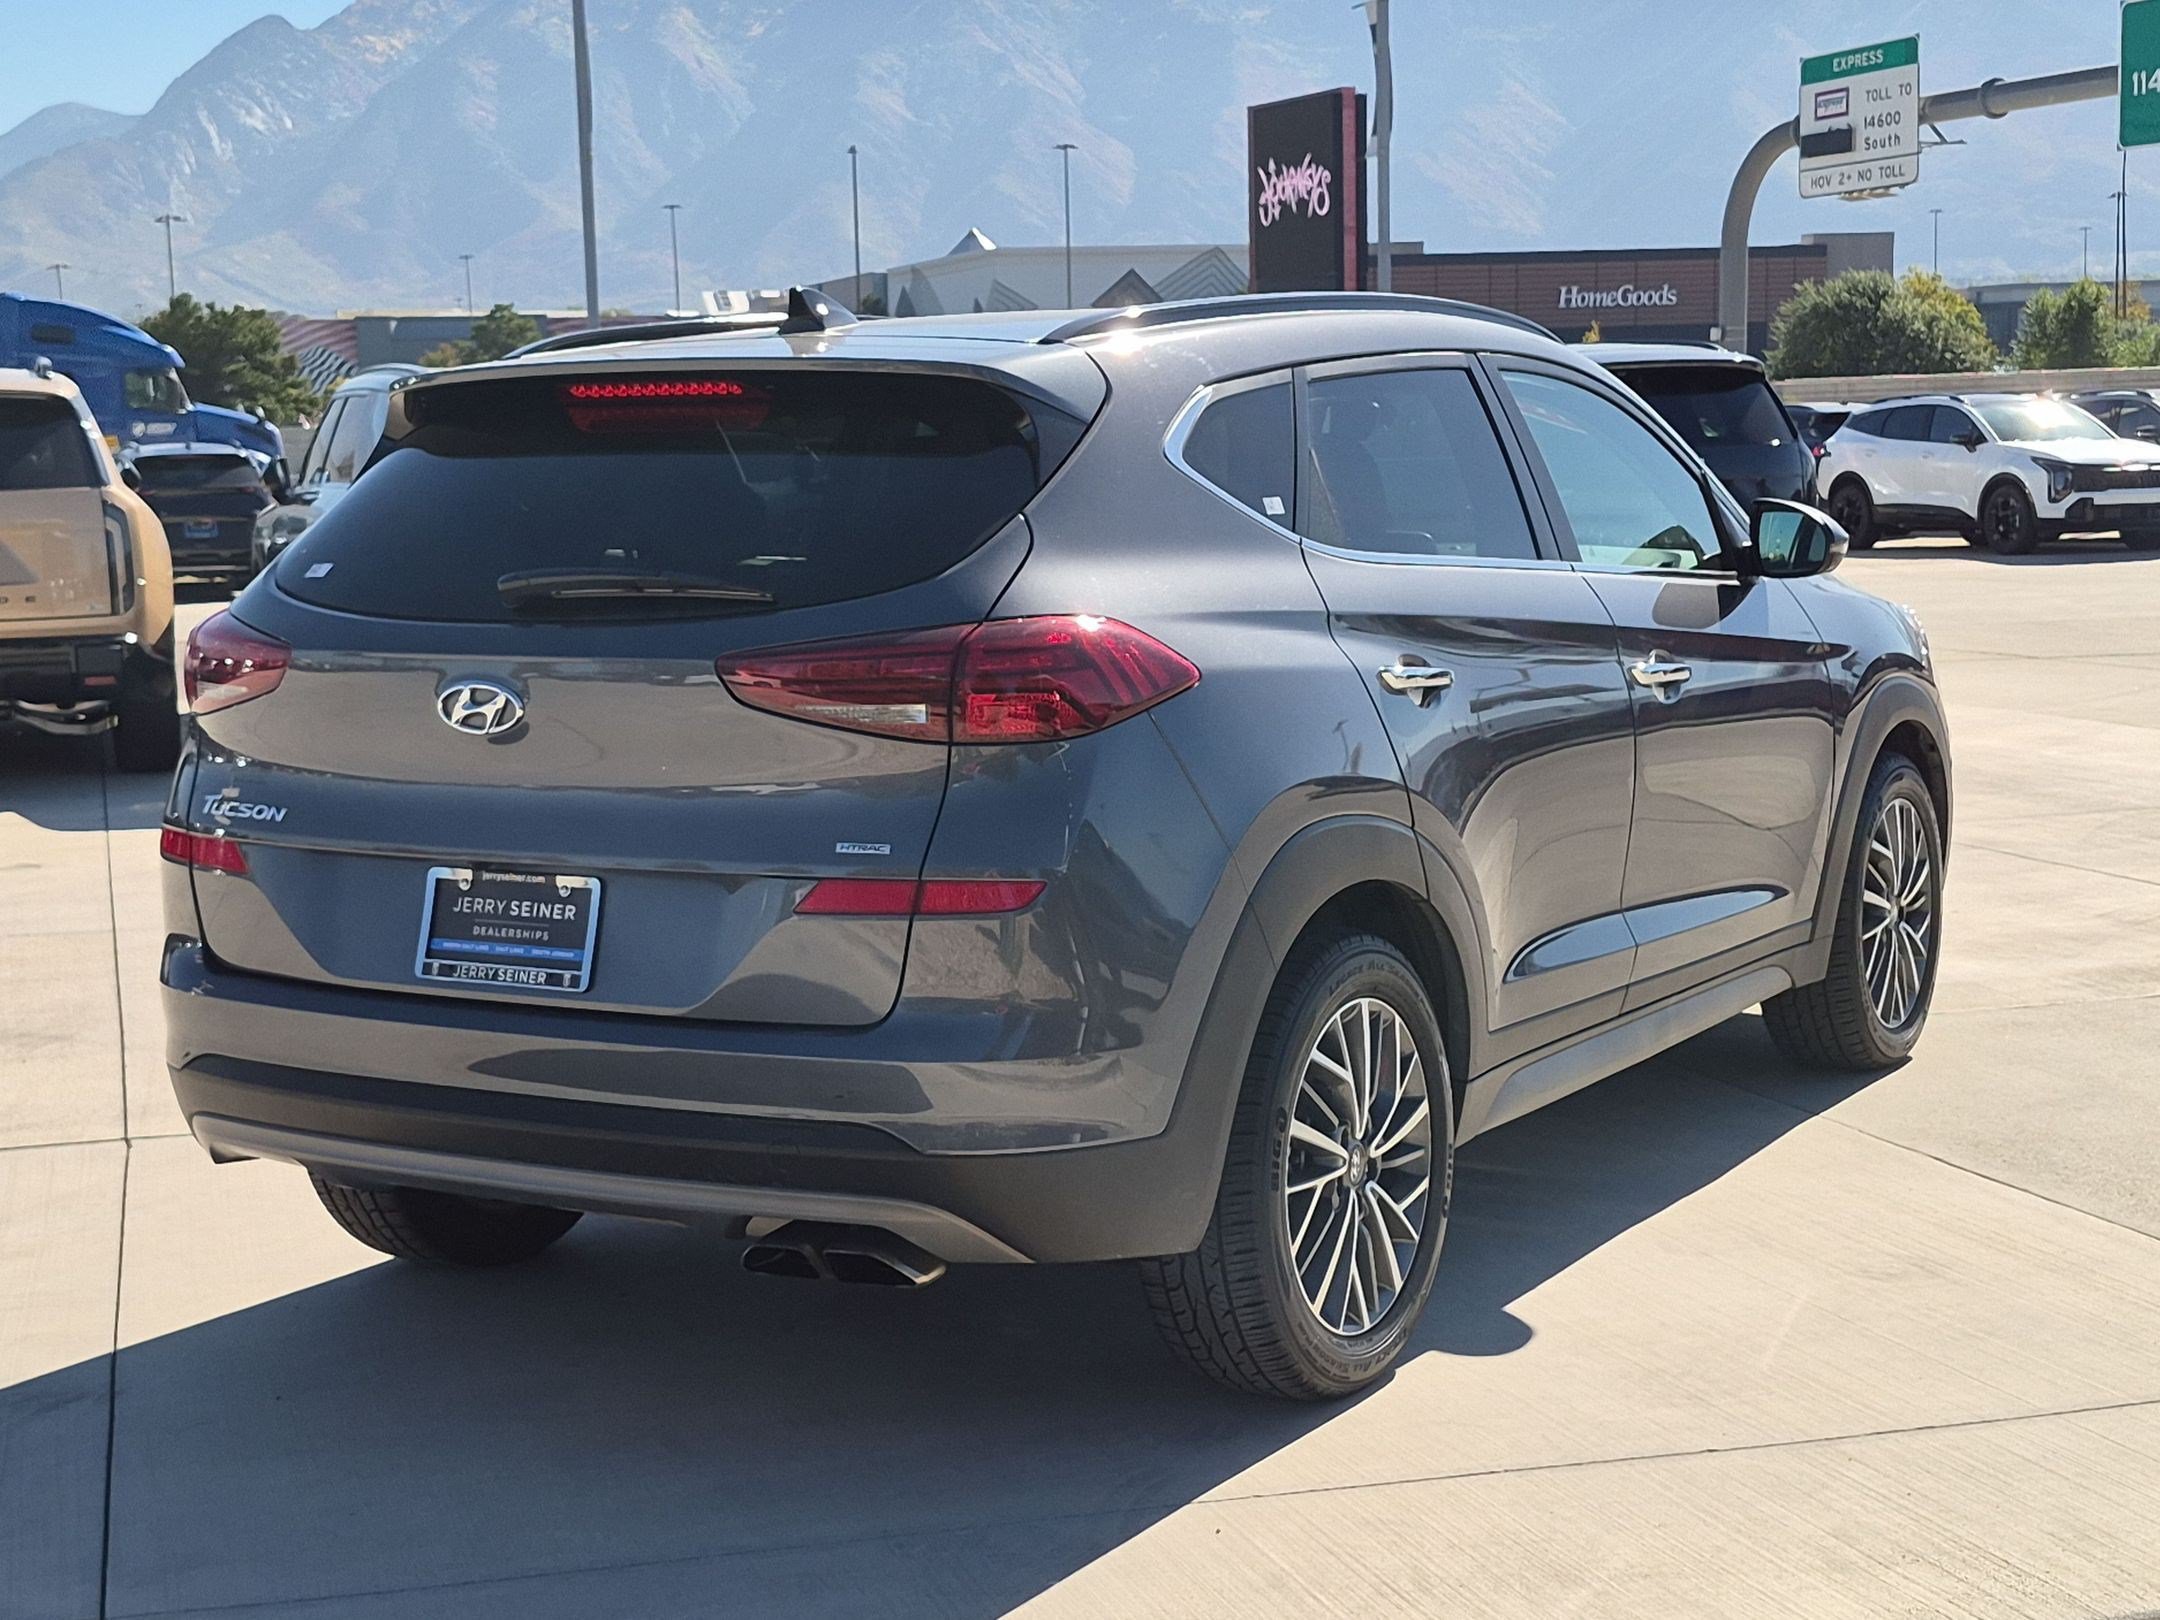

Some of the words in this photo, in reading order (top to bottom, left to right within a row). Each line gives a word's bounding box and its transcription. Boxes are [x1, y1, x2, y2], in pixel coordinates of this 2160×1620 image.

[1832, 49, 1884, 72] EXPRESS
[1865, 87, 1892, 103] TOLL
[1898, 82, 1912, 97] TO
[2132, 68, 2160, 96] 114
[1864, 111, 1901, 130] 14600
[1864, 133, 1901, 150] South
[1810, 175, 1832, 189] HOV
[1838, 172, 1852, 186] 2+
[1857, 169, 1873, 182] NO
[1878, 165, 1905, 179] TOLL
[1558, 283, 1678, 308] HomeGoods
[202, 794, 288, 822] TUCSON
[836, 843, 890, 854] HTRAC
[452, 897, 507, 914] JERRY
[509, 900, 577, 920] SEINER
[473, 925, 549, 941] DEALERSHIPS
[452, 965, 496, 980] JERRY
[497, 968, 547, 985] SEINER
